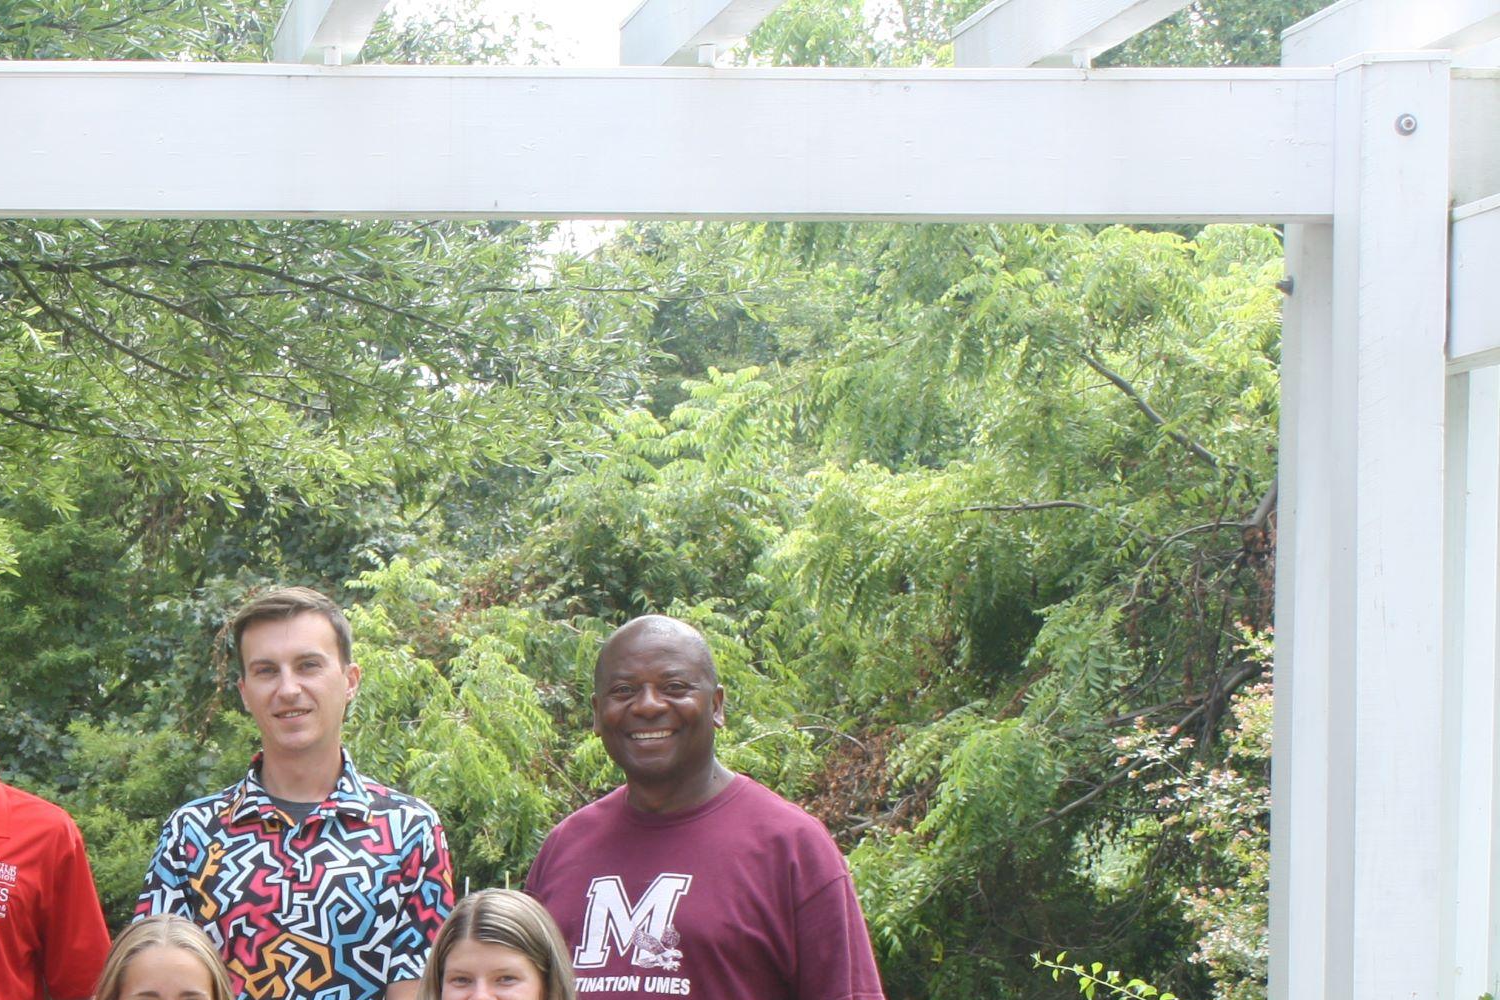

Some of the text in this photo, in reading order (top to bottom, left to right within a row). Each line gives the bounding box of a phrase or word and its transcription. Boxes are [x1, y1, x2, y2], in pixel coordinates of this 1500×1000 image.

[573, 873, 693, 969] M
[575, 976, 690, 995] TINATION UMES
